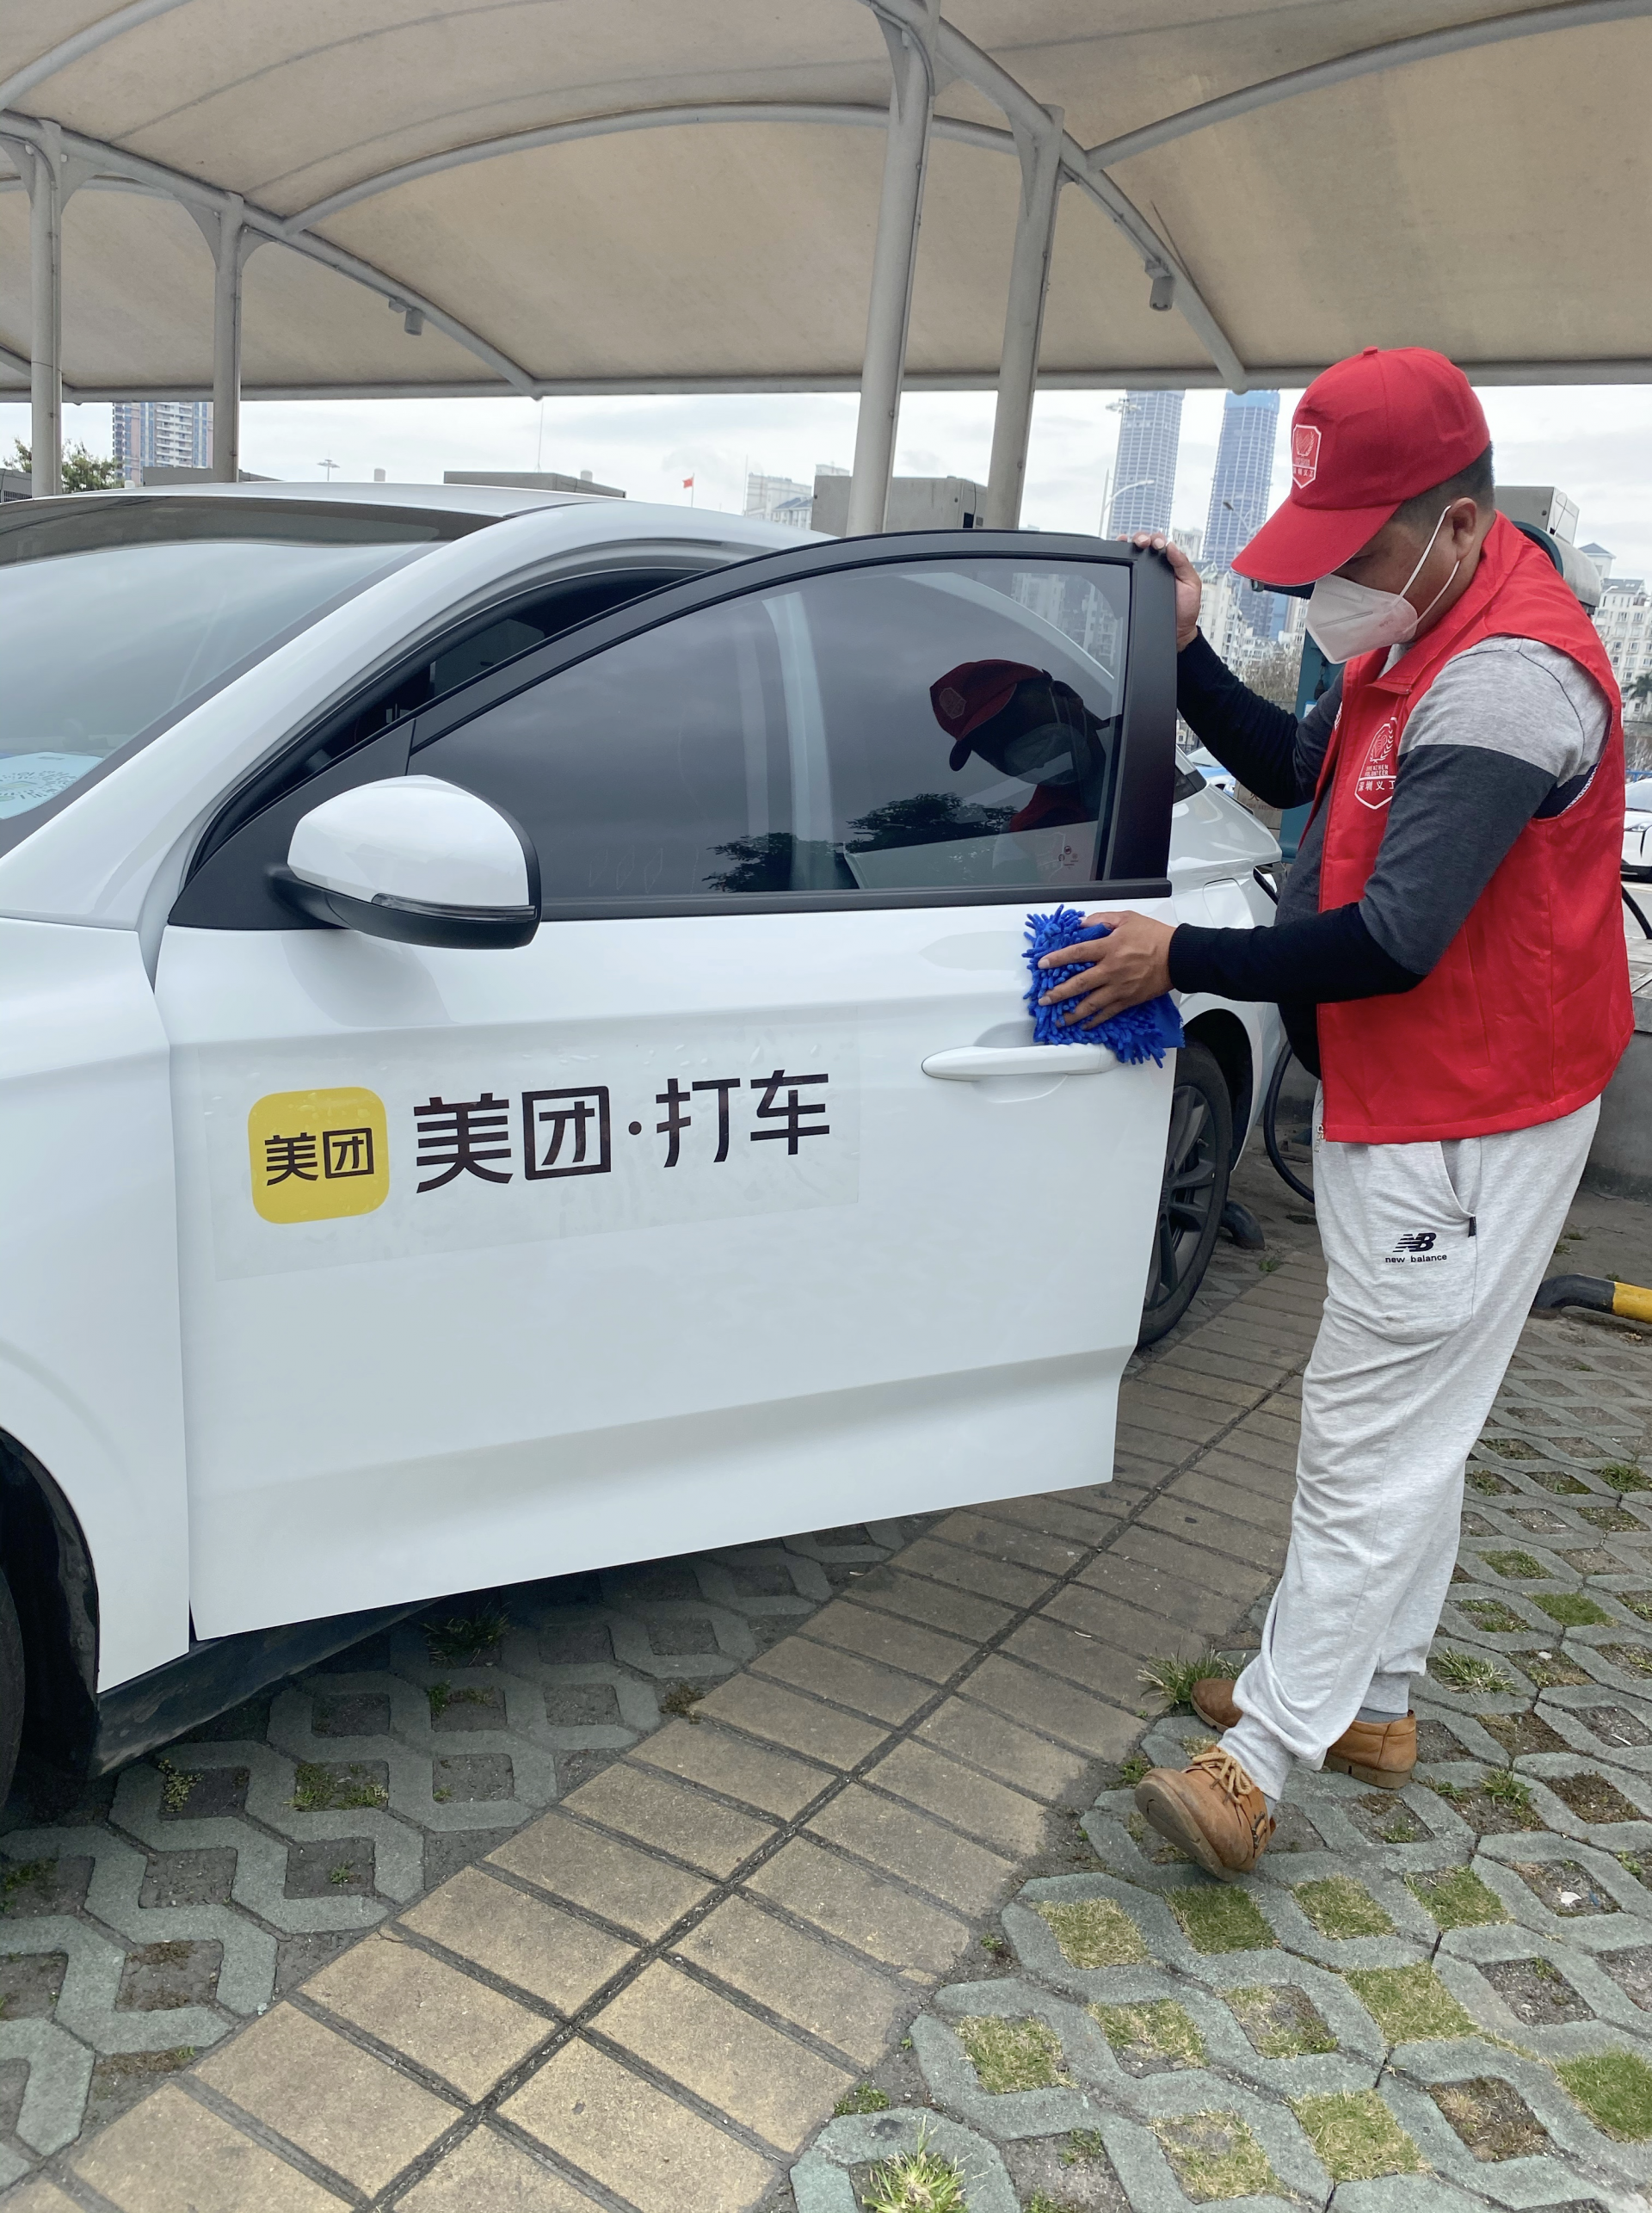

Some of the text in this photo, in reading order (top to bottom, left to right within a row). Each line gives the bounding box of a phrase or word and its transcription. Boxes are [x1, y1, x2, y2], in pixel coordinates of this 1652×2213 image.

[264, 1128, 375, 1187] 美团
[413, 1069, 830, 1194] 美团·打车
[1410, 1254, 1447, 1263] balance
